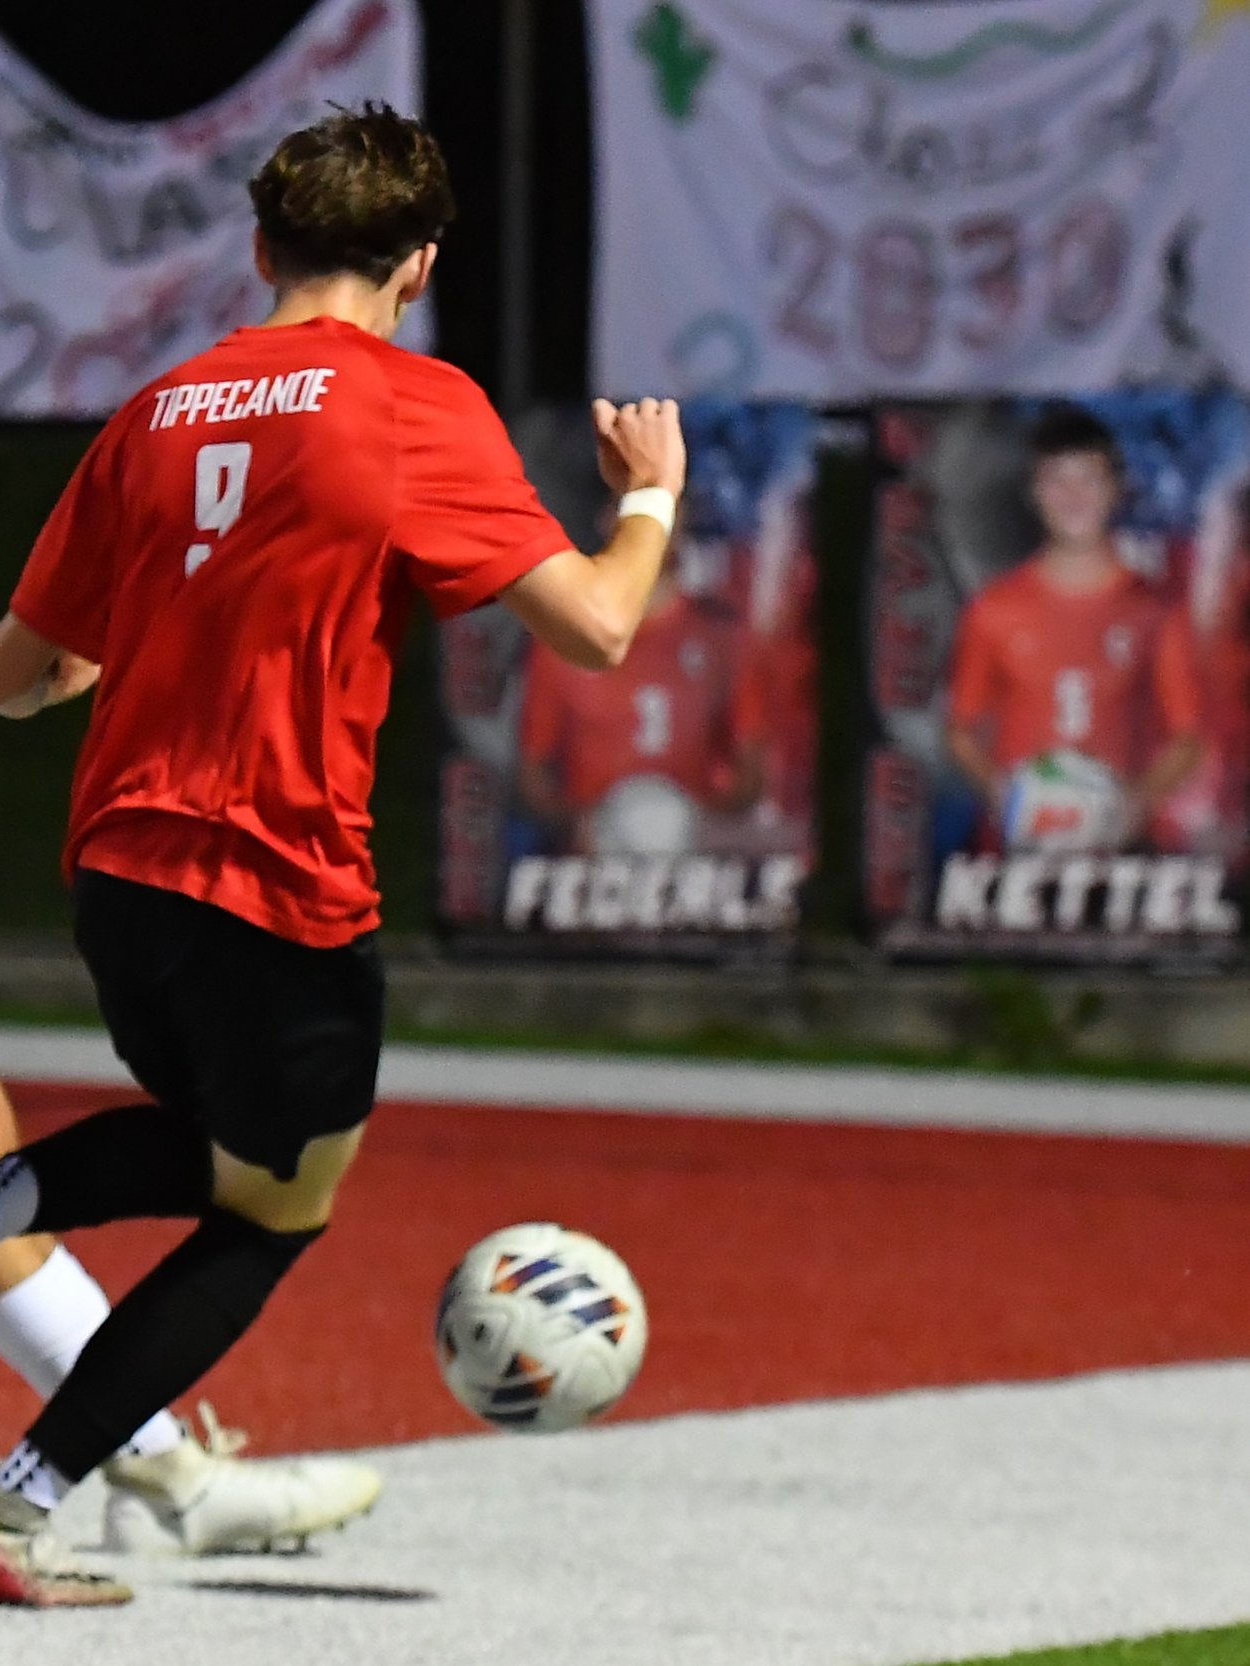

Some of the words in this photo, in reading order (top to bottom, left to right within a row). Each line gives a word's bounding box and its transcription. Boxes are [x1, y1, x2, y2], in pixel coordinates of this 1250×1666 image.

[760, 202, 1132, 370] 2030
[149, 367, 337, 433] TIPPECANOE
[184, 441, 253, 579] 9
[937, 853, 1240, 936] KETTEL
